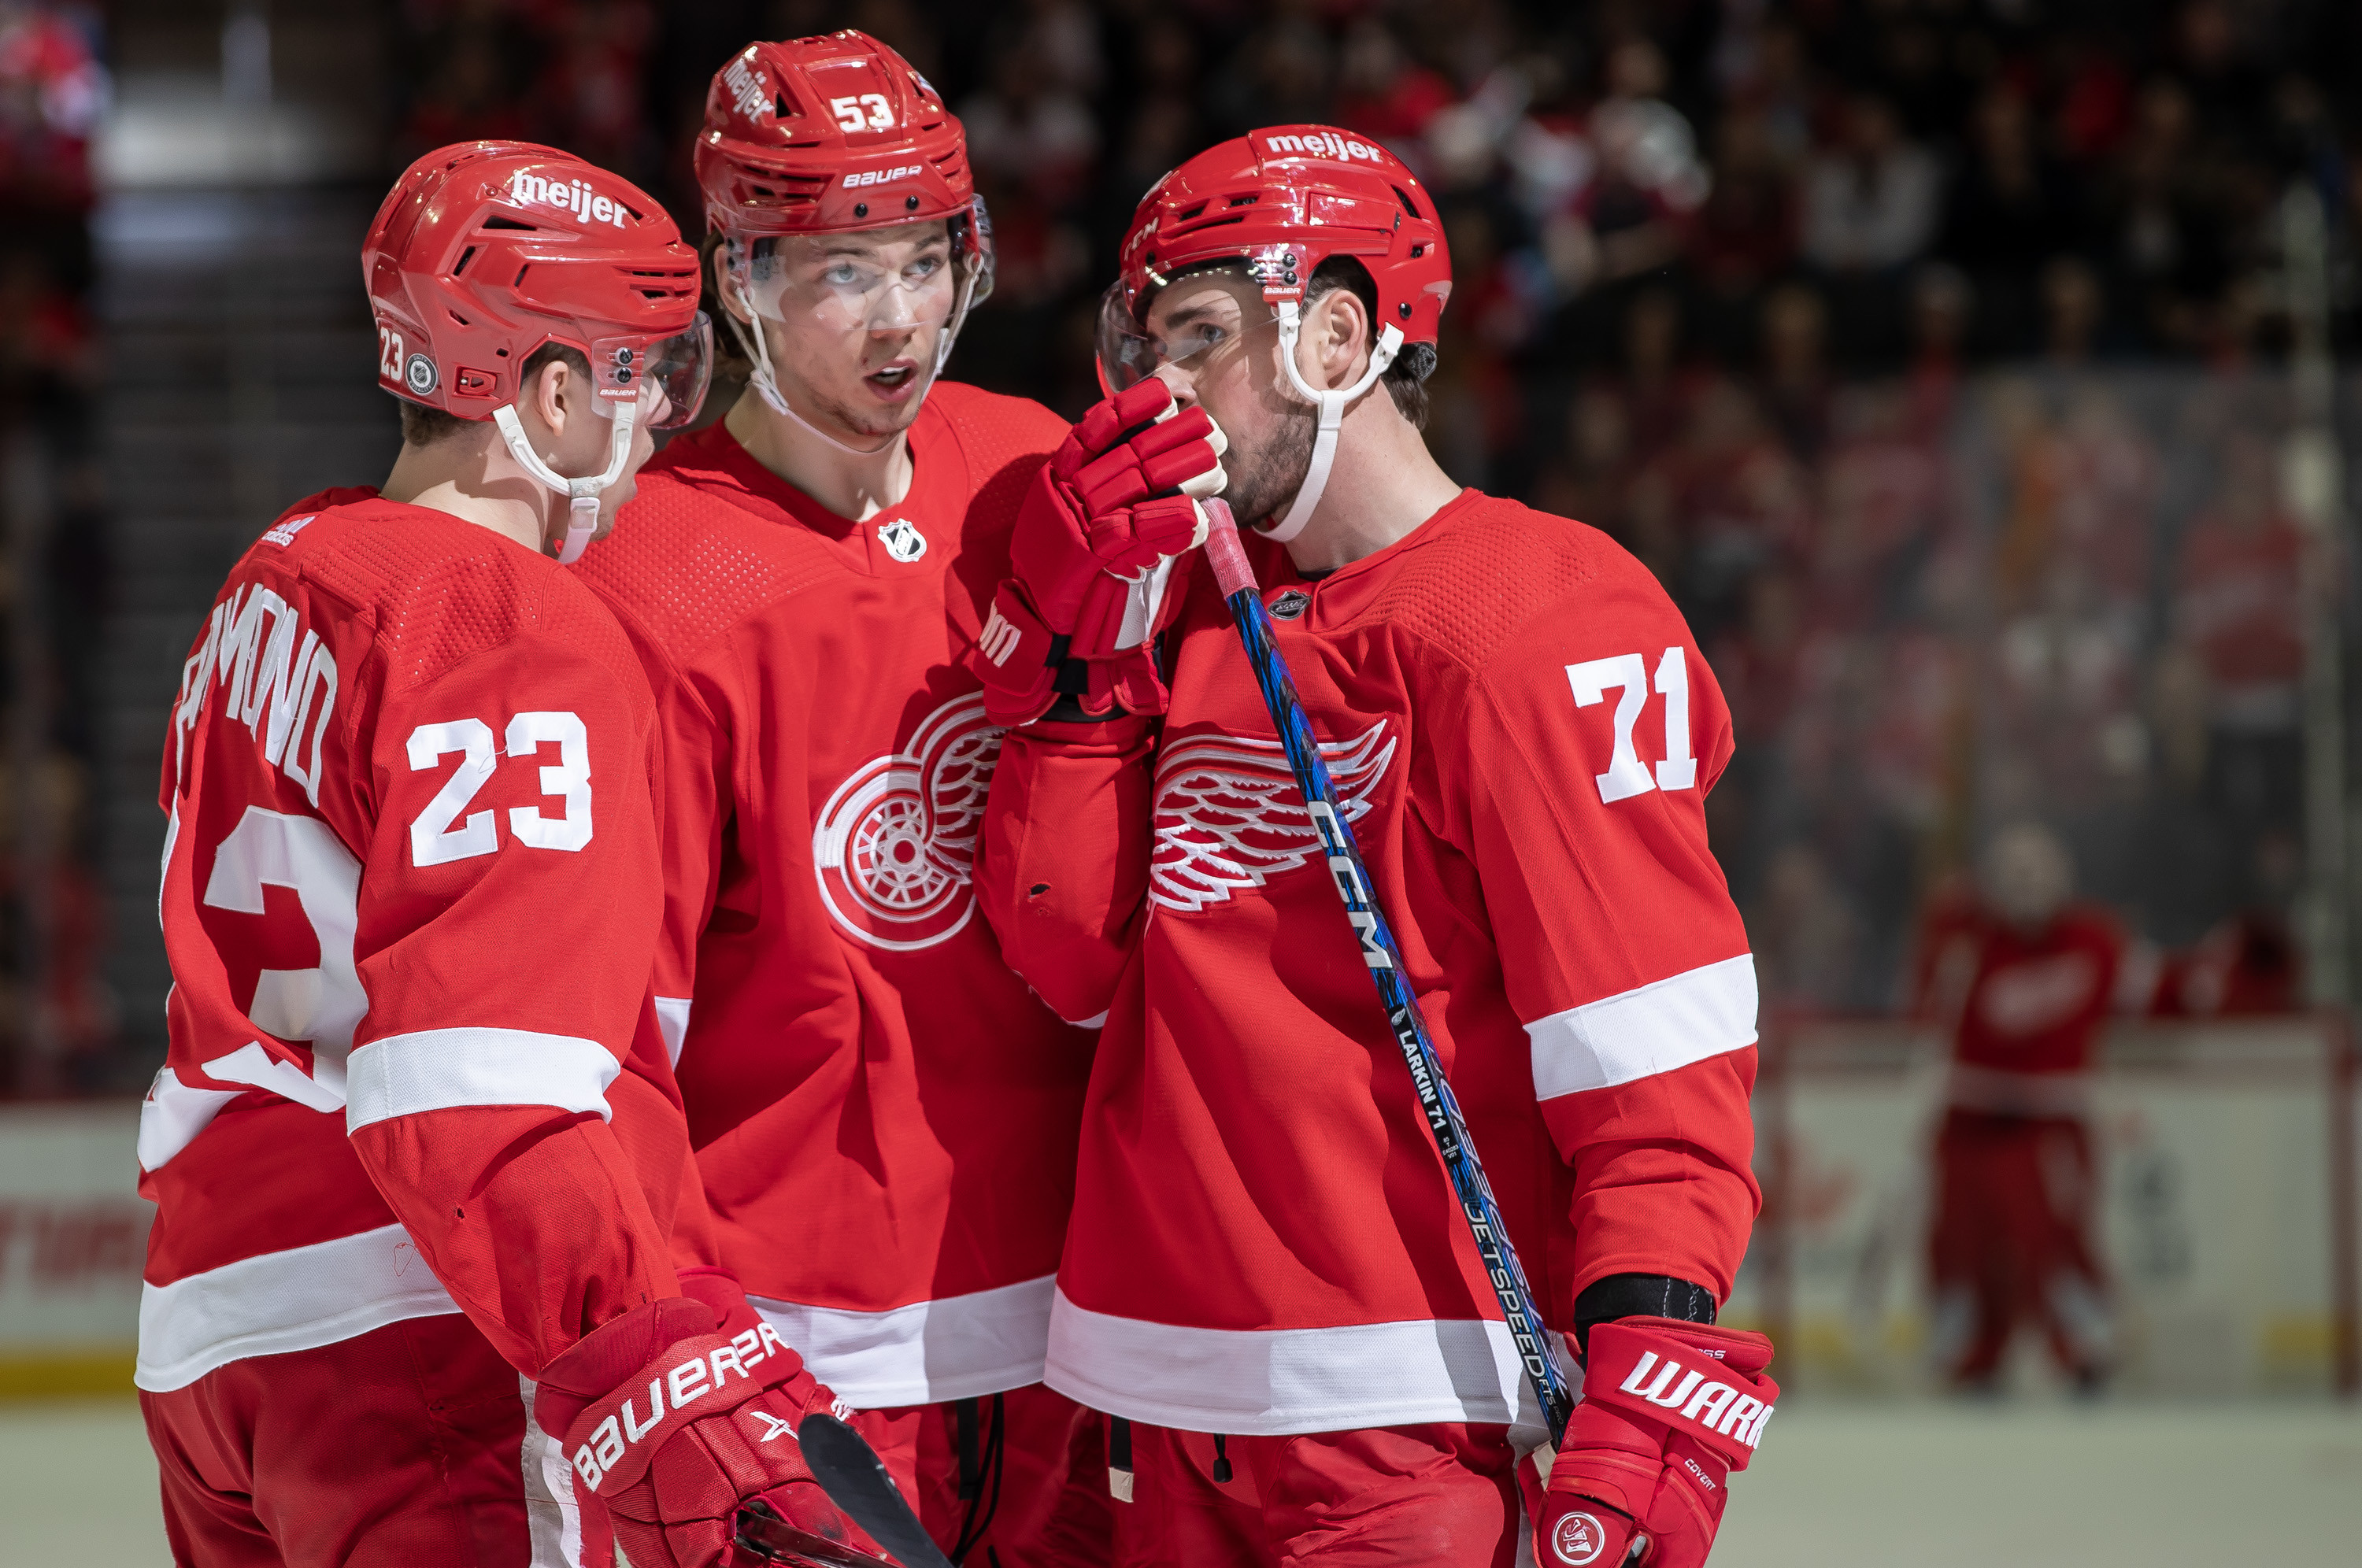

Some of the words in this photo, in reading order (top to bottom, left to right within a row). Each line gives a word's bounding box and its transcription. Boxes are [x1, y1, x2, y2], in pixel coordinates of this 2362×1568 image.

[723, 58, 775, 124] meijer
[829, 93, 896, 133] 53
[842, 165, 923, 189] BAUER
[1265, 131, 1384, 164] meijer
[512, 171, 628, 229] meijer
[379, 326, 404, 382] 23
[599, 388, 637, 397] BAUER
[1564, 645, 1698, 805] 71
[405, 711, 594, 867] 23
[1307, 800, 1393, 969] CCM
[1398, 1030, 1438, 1104] LARKIN
[1428, 1104, 1447, 1130] 71
[1464, 1202, 1546, 1378] JETSPEED
[1538, 1378, 1557, 1406] FT5
[1553, 1405, 1564, 1425] PRO
[572, 1346, 750, 1492] BAUER
[1683, 1457, 1716, 1492] COVERT
